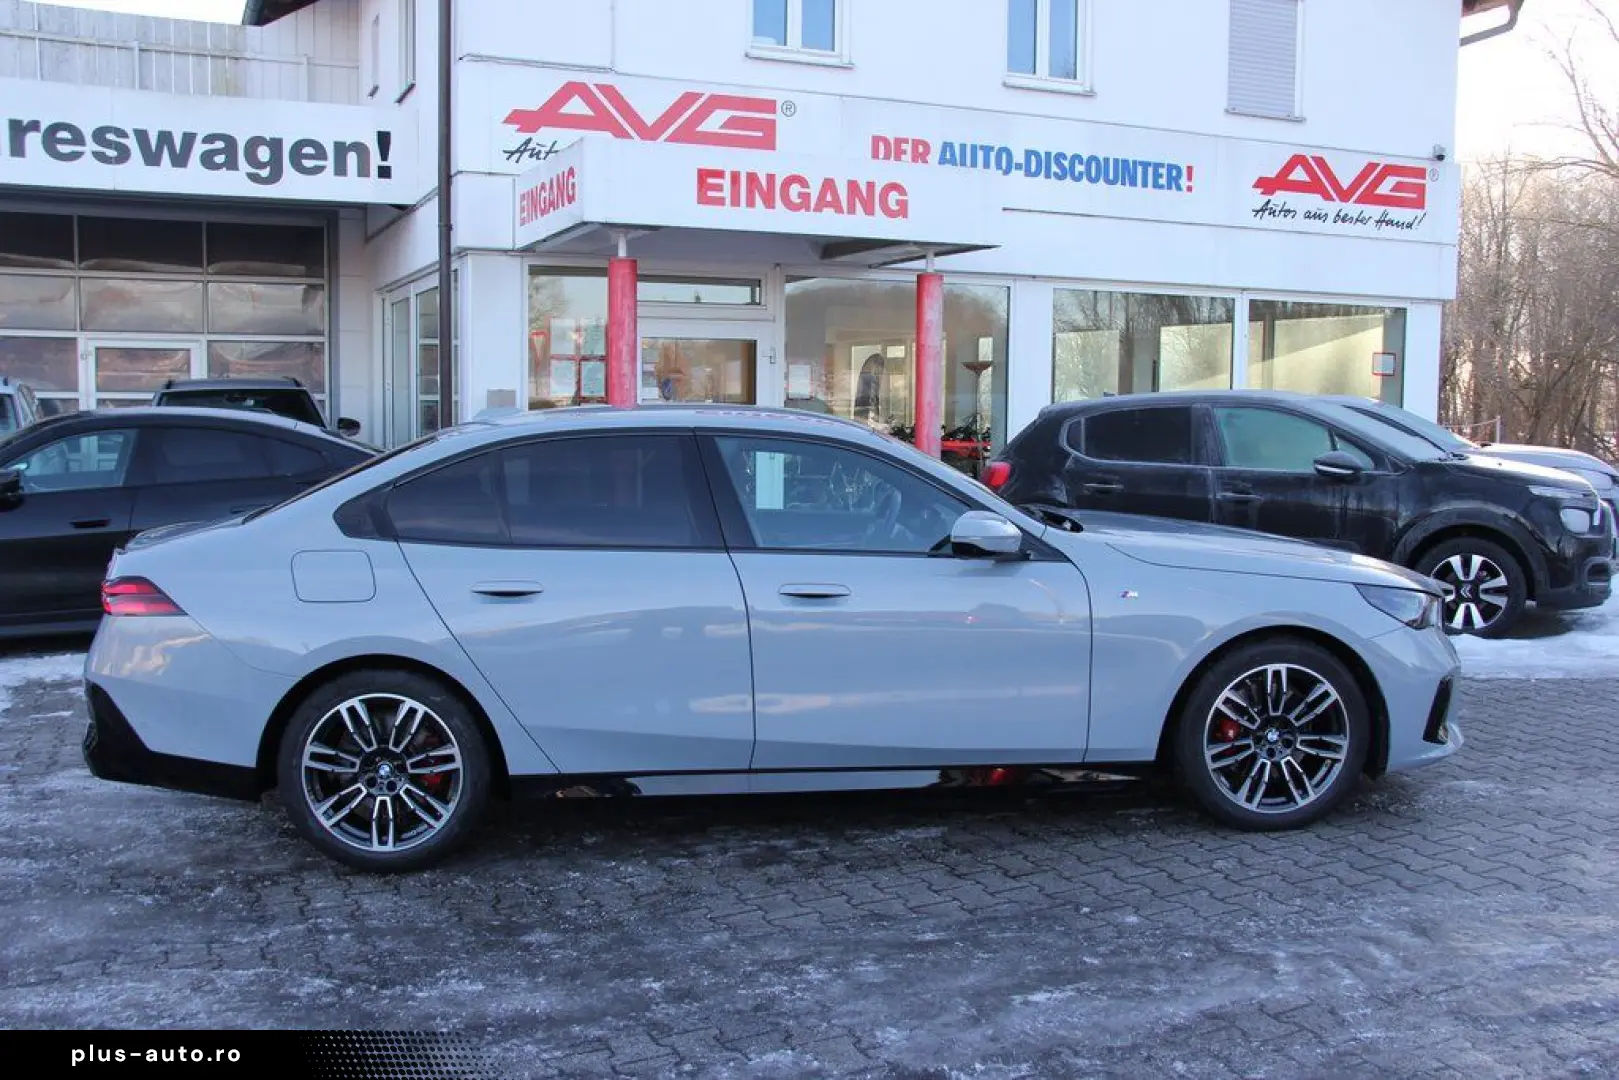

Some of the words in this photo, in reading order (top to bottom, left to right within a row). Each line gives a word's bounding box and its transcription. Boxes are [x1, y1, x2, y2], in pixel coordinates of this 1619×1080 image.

[502, 81, 777, 151] AVG
[8, 117, 393, 186] reswagen!
[503, 137, 560, 164] Aut
[871, 134, 931, 164] DER
[519, 166, 577, 227] EINGANG
[696, 167, 909, 219] EINGANG
[1252, 154, 1427, 210] AVG
[1374, 209, 1427, 231] Hand!
